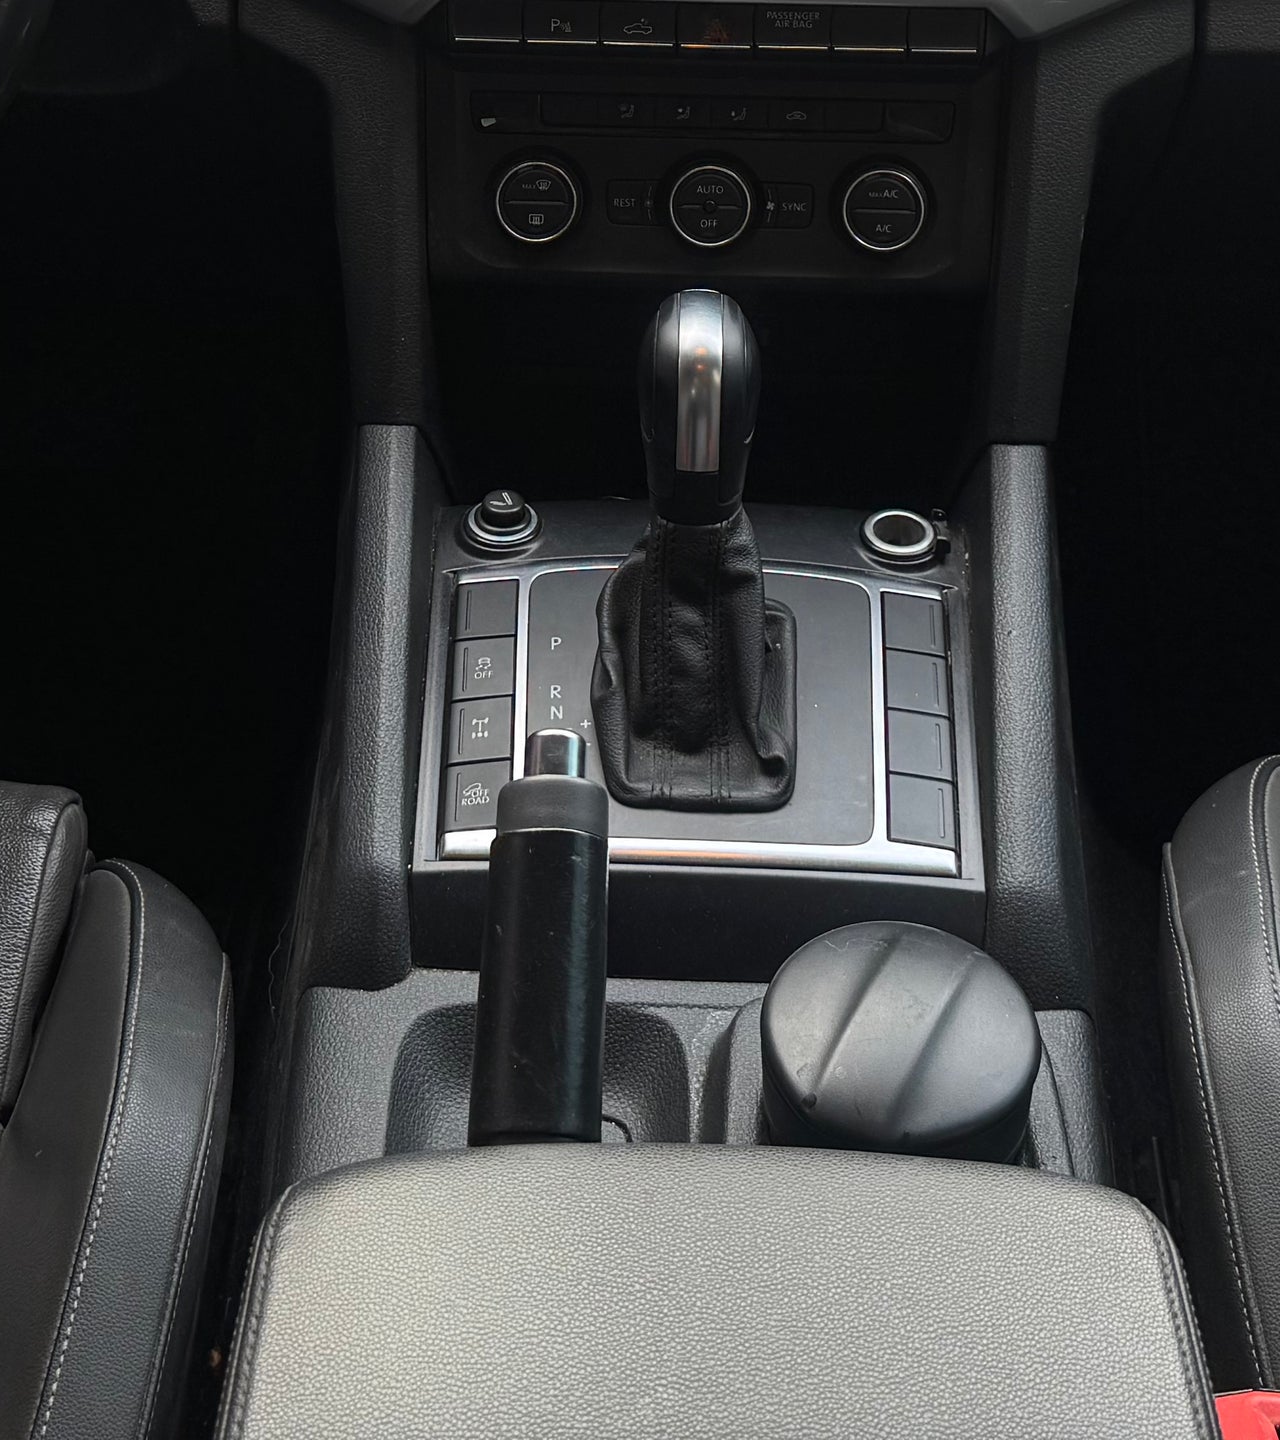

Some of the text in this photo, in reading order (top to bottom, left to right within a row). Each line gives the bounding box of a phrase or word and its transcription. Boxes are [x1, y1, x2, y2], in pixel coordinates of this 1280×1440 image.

[766, 10, 821, 20] PASSENGER
[775, 19, 813, 29] AIR BAG
[696, 185, 724, 195] AUTO
[883, 189, 900, 199] A/C
[612, 197, 637, 208] REST
[781, 202, 807, 212] SYNC
[700, 219, 718, 228] OFF
[875, 223, 893, 233] A/C
[550, 636, 562, 650] P
[474, 670, 493, 680] OFF
[550, 684, 562, 699] R
[550, 705, 563, 720] N
[471, 788, 489, 798] OFF
[461, 795, 490, 806] ROAD
